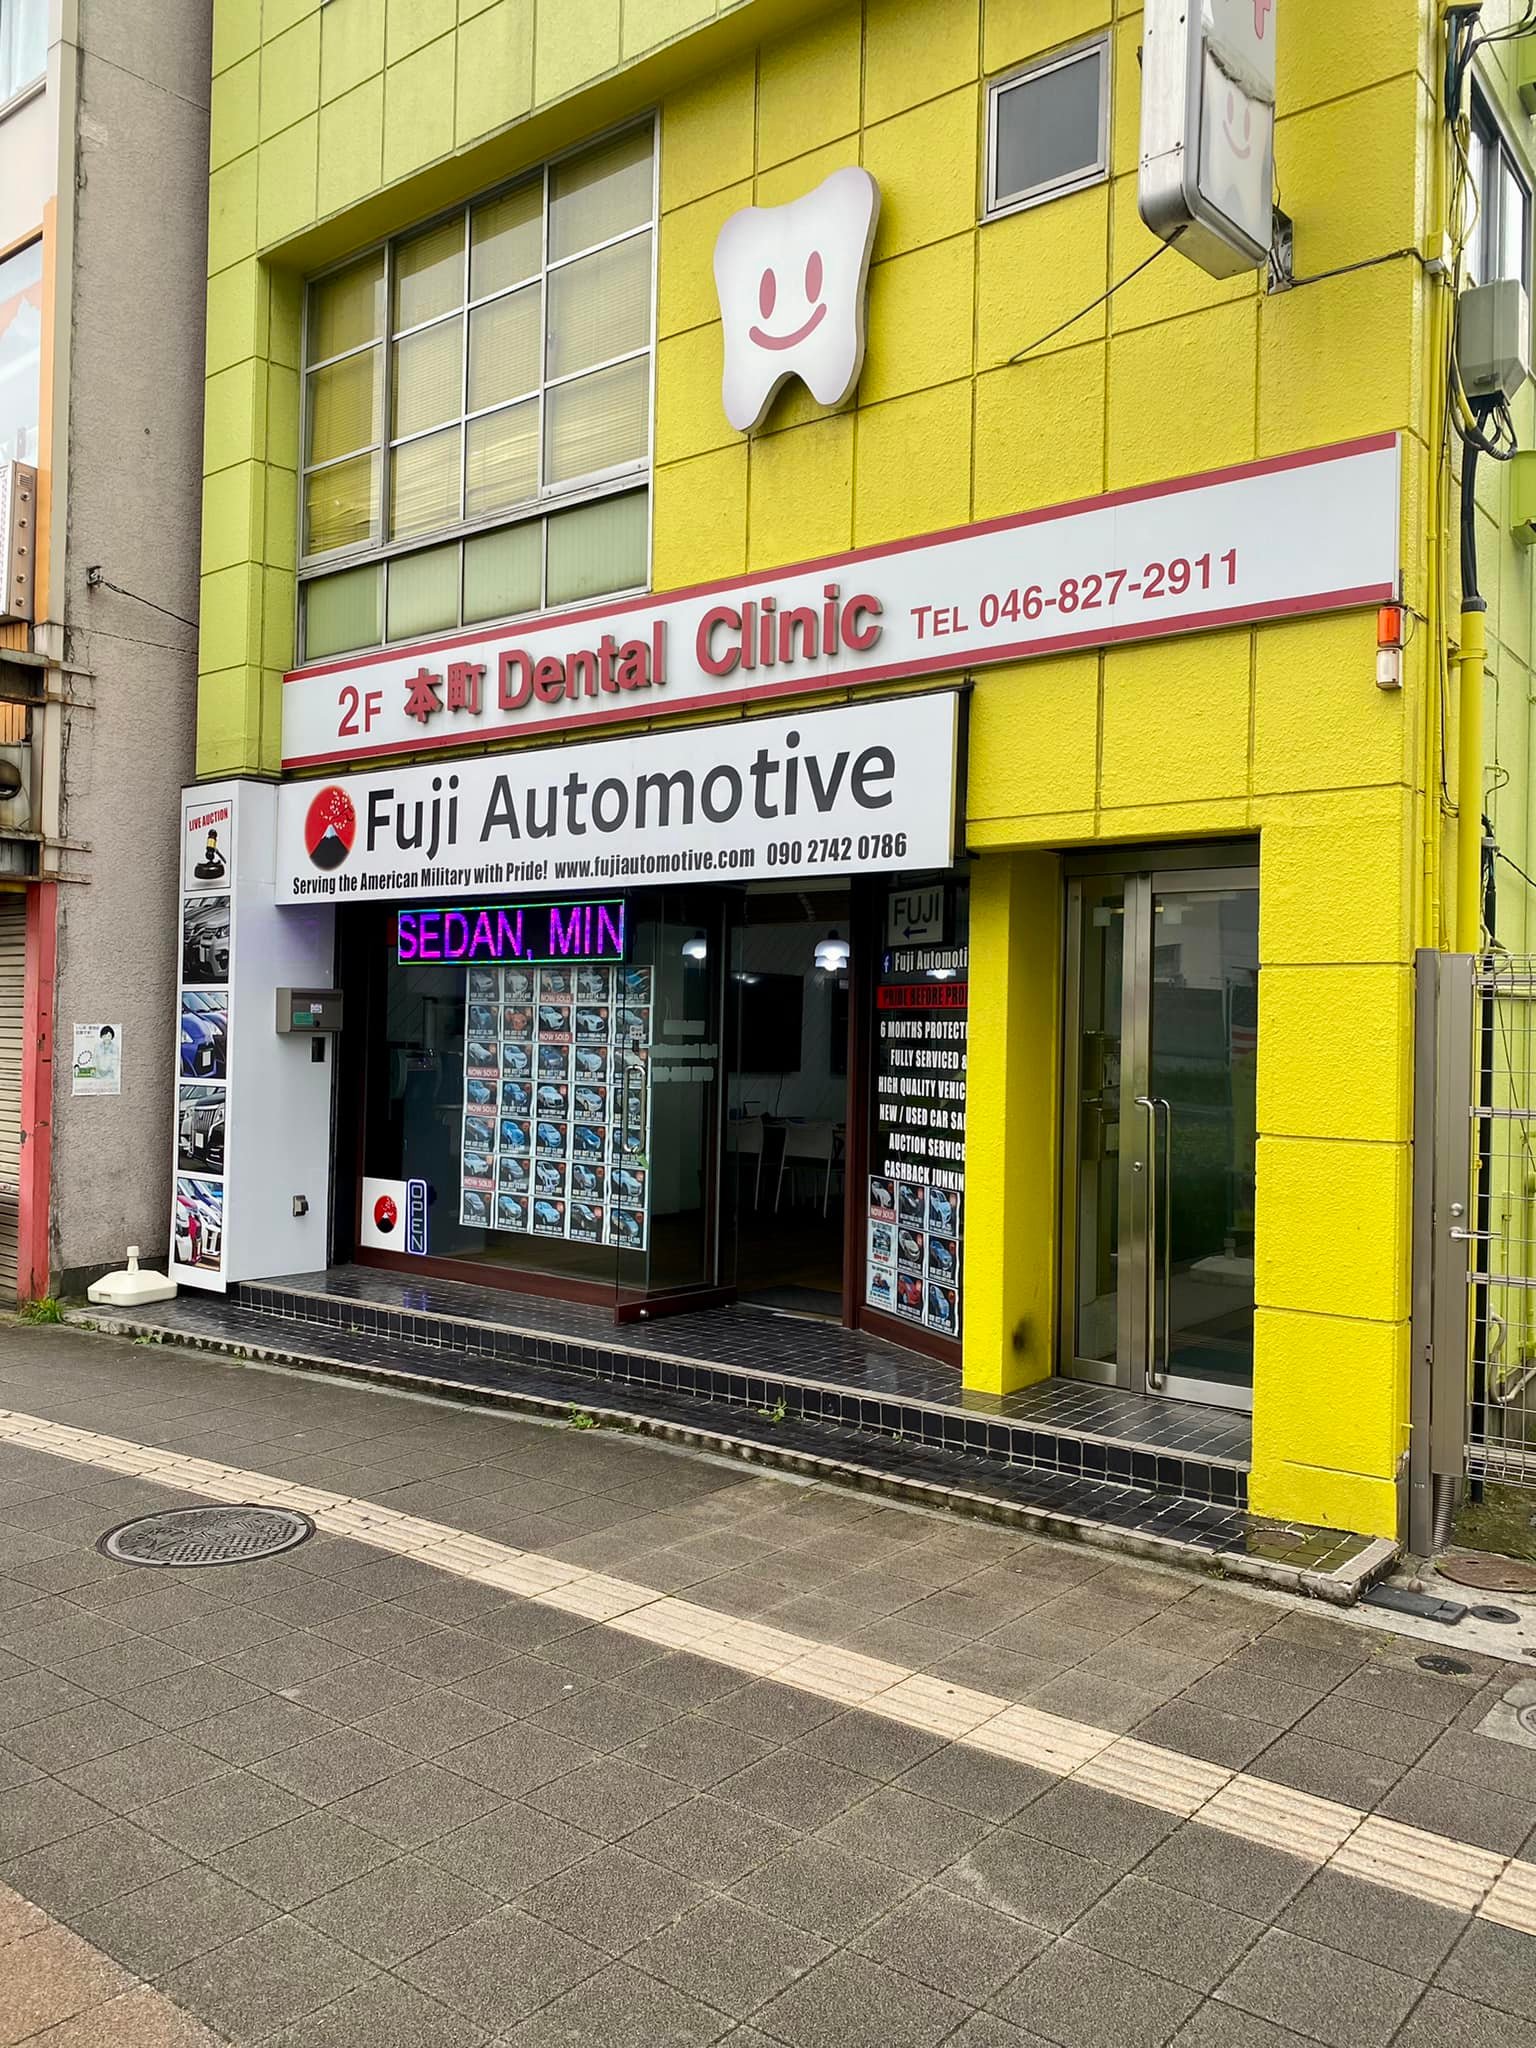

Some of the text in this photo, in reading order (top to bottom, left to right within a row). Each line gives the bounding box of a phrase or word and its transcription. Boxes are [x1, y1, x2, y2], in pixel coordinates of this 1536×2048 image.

[338, 547, 1238, 737] 2F 本町 Dental Clinic TEL 046-827-2911
[366, 729, 897, 861] Fuji Automotive
[188, 808, 229, 832] LIVE AUCTION
[293, 832, 907, 895] Serving the American Military with Pride! www.fujiautomotive.com 090 2742 0786
[893, 893, 940, 926] FUJI
[399, 910, 532, 960] SEDAN,
[894, 951, 914, 973] Fuji
[540, 1032, 553, 1041] NOW
[554, 1033, 569, 1041] SOLD
[880, 1021, 886, 1038] 6
[887, 1021, 923, 1039] MONTHS
[890, 1049, 914, 1067] FULLY
[915, 1050, 959, 1069] SERVICED
[878, 1075, 966, 1100] HIGH QUALITY VEHIC
[880, 1103, 898, 1122] NEW
[905, 1106, 928, 1126] USED
[930, 1109, 949, 1128] CAR
[889, 1132, 926, 1155] AUCTION
[884, 1160, 930, 1185] CASHBACK
[411, 1184, 423, 1251] OPEN
